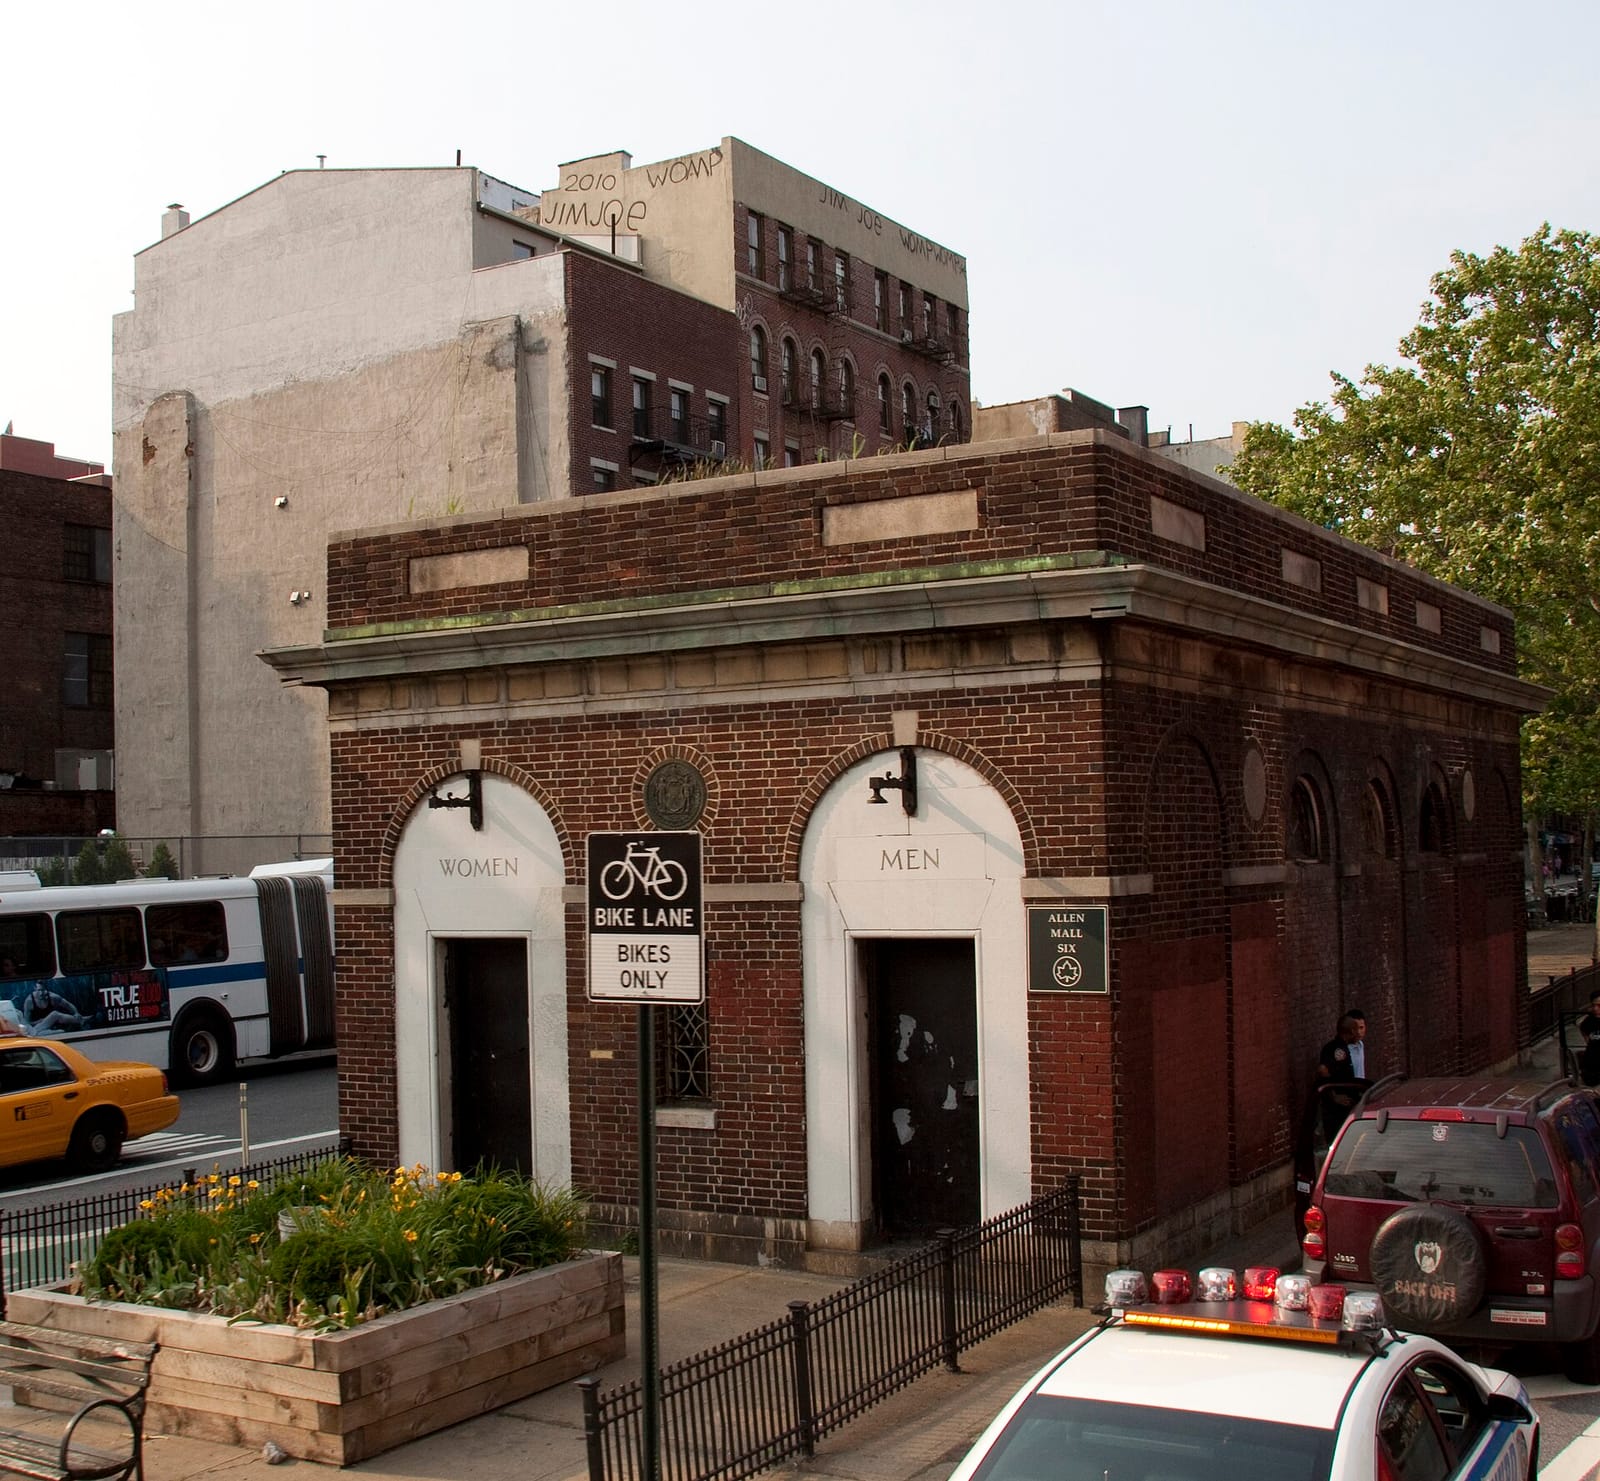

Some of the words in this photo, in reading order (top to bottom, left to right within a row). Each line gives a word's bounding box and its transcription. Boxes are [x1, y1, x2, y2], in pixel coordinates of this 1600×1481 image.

[646, 150, 723, 188] WOMP
[565, 174, 617, 192] 2010
[819, 187, 849, 213] JIM
[439, 857, 518, 877] WOMEN
[880, 848, 940, 871] MEN
[594, 908, 636, 927] BIKE
[643, 908, 695, 927] LANE
[1048, 913, 1085, 923] ALLEN
[1050, 928, 1083, 938] MALL
[618, 944, 671, 963] BIKES
[1057, 943, 1076, 953] SIX
[620, 970, 668, 989] ONLY
[99, 984, 140, 1007] TRUE
[108, 1008, 125, 1021] 6/13
[1521, 1270, 1545, 1278] 3.7L
[1395, 1280, 1426, 1296] BACK
